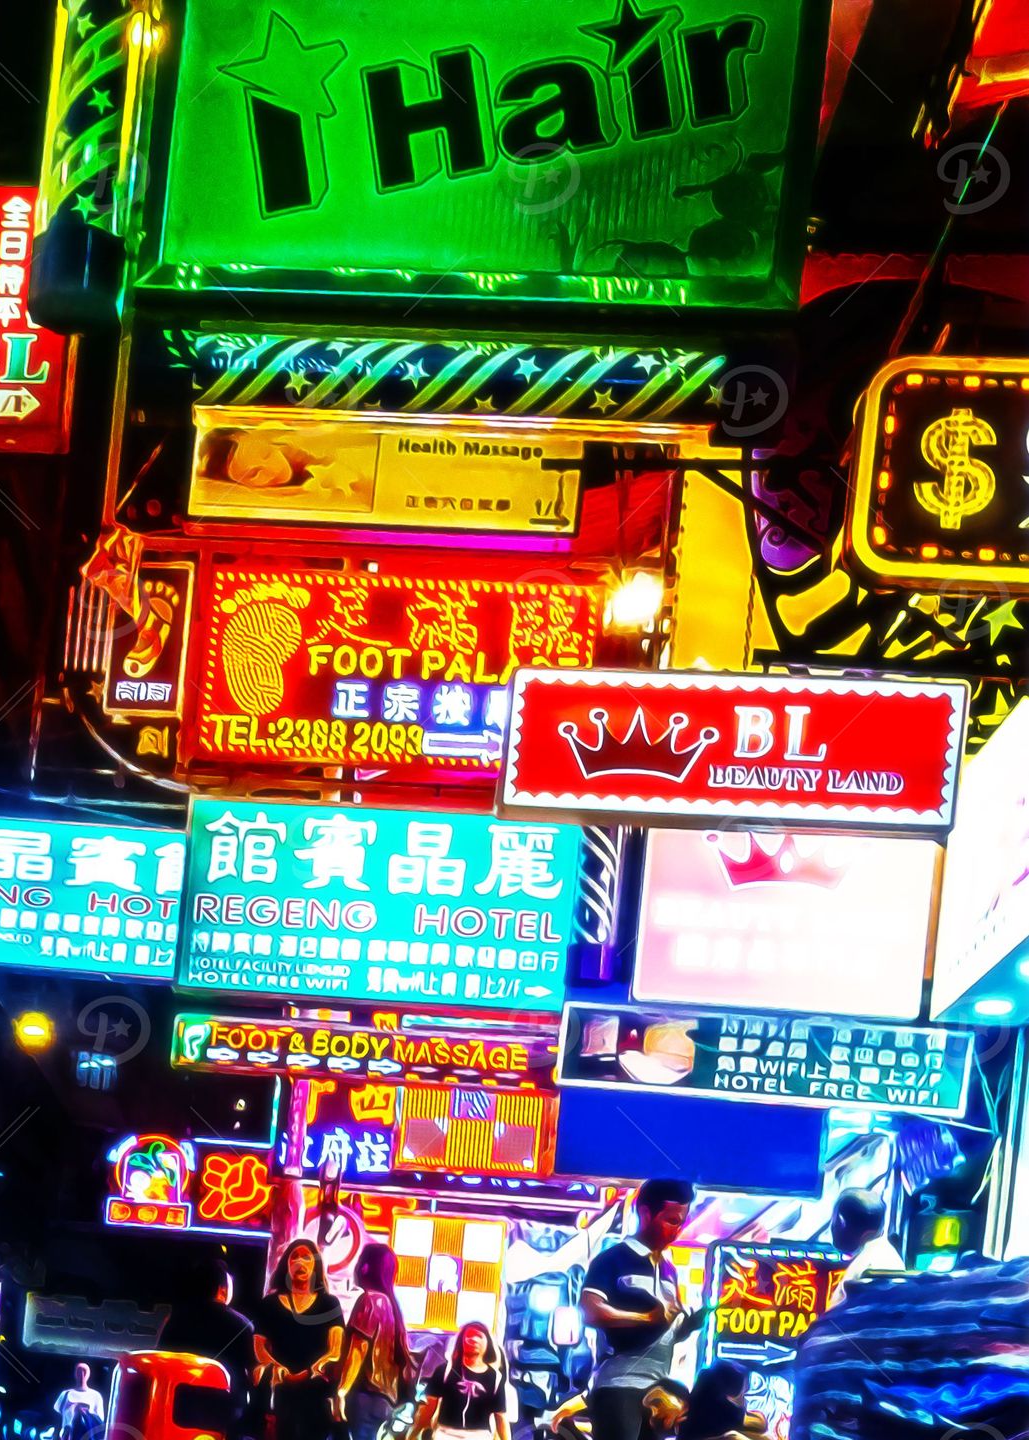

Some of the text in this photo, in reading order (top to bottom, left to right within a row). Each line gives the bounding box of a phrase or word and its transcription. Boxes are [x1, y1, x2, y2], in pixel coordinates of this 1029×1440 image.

[398, 438, 457, 456] Health
[308, 645, 413, 681] FOOT
[708, 765, 904, 796] BEAUTY LAND
[193, 894, 377, 932] REGENG
[414, 903, 563, 943] HOTEL
[188, 971, 249, 985] HOTEL
[208, 1023, 529, 1072] FOOT & BODY MASSAGE
[714, 1073, 938, 1105] HOTEL FREE WIFI
[716, 1308, 776, 1335] FOOT
